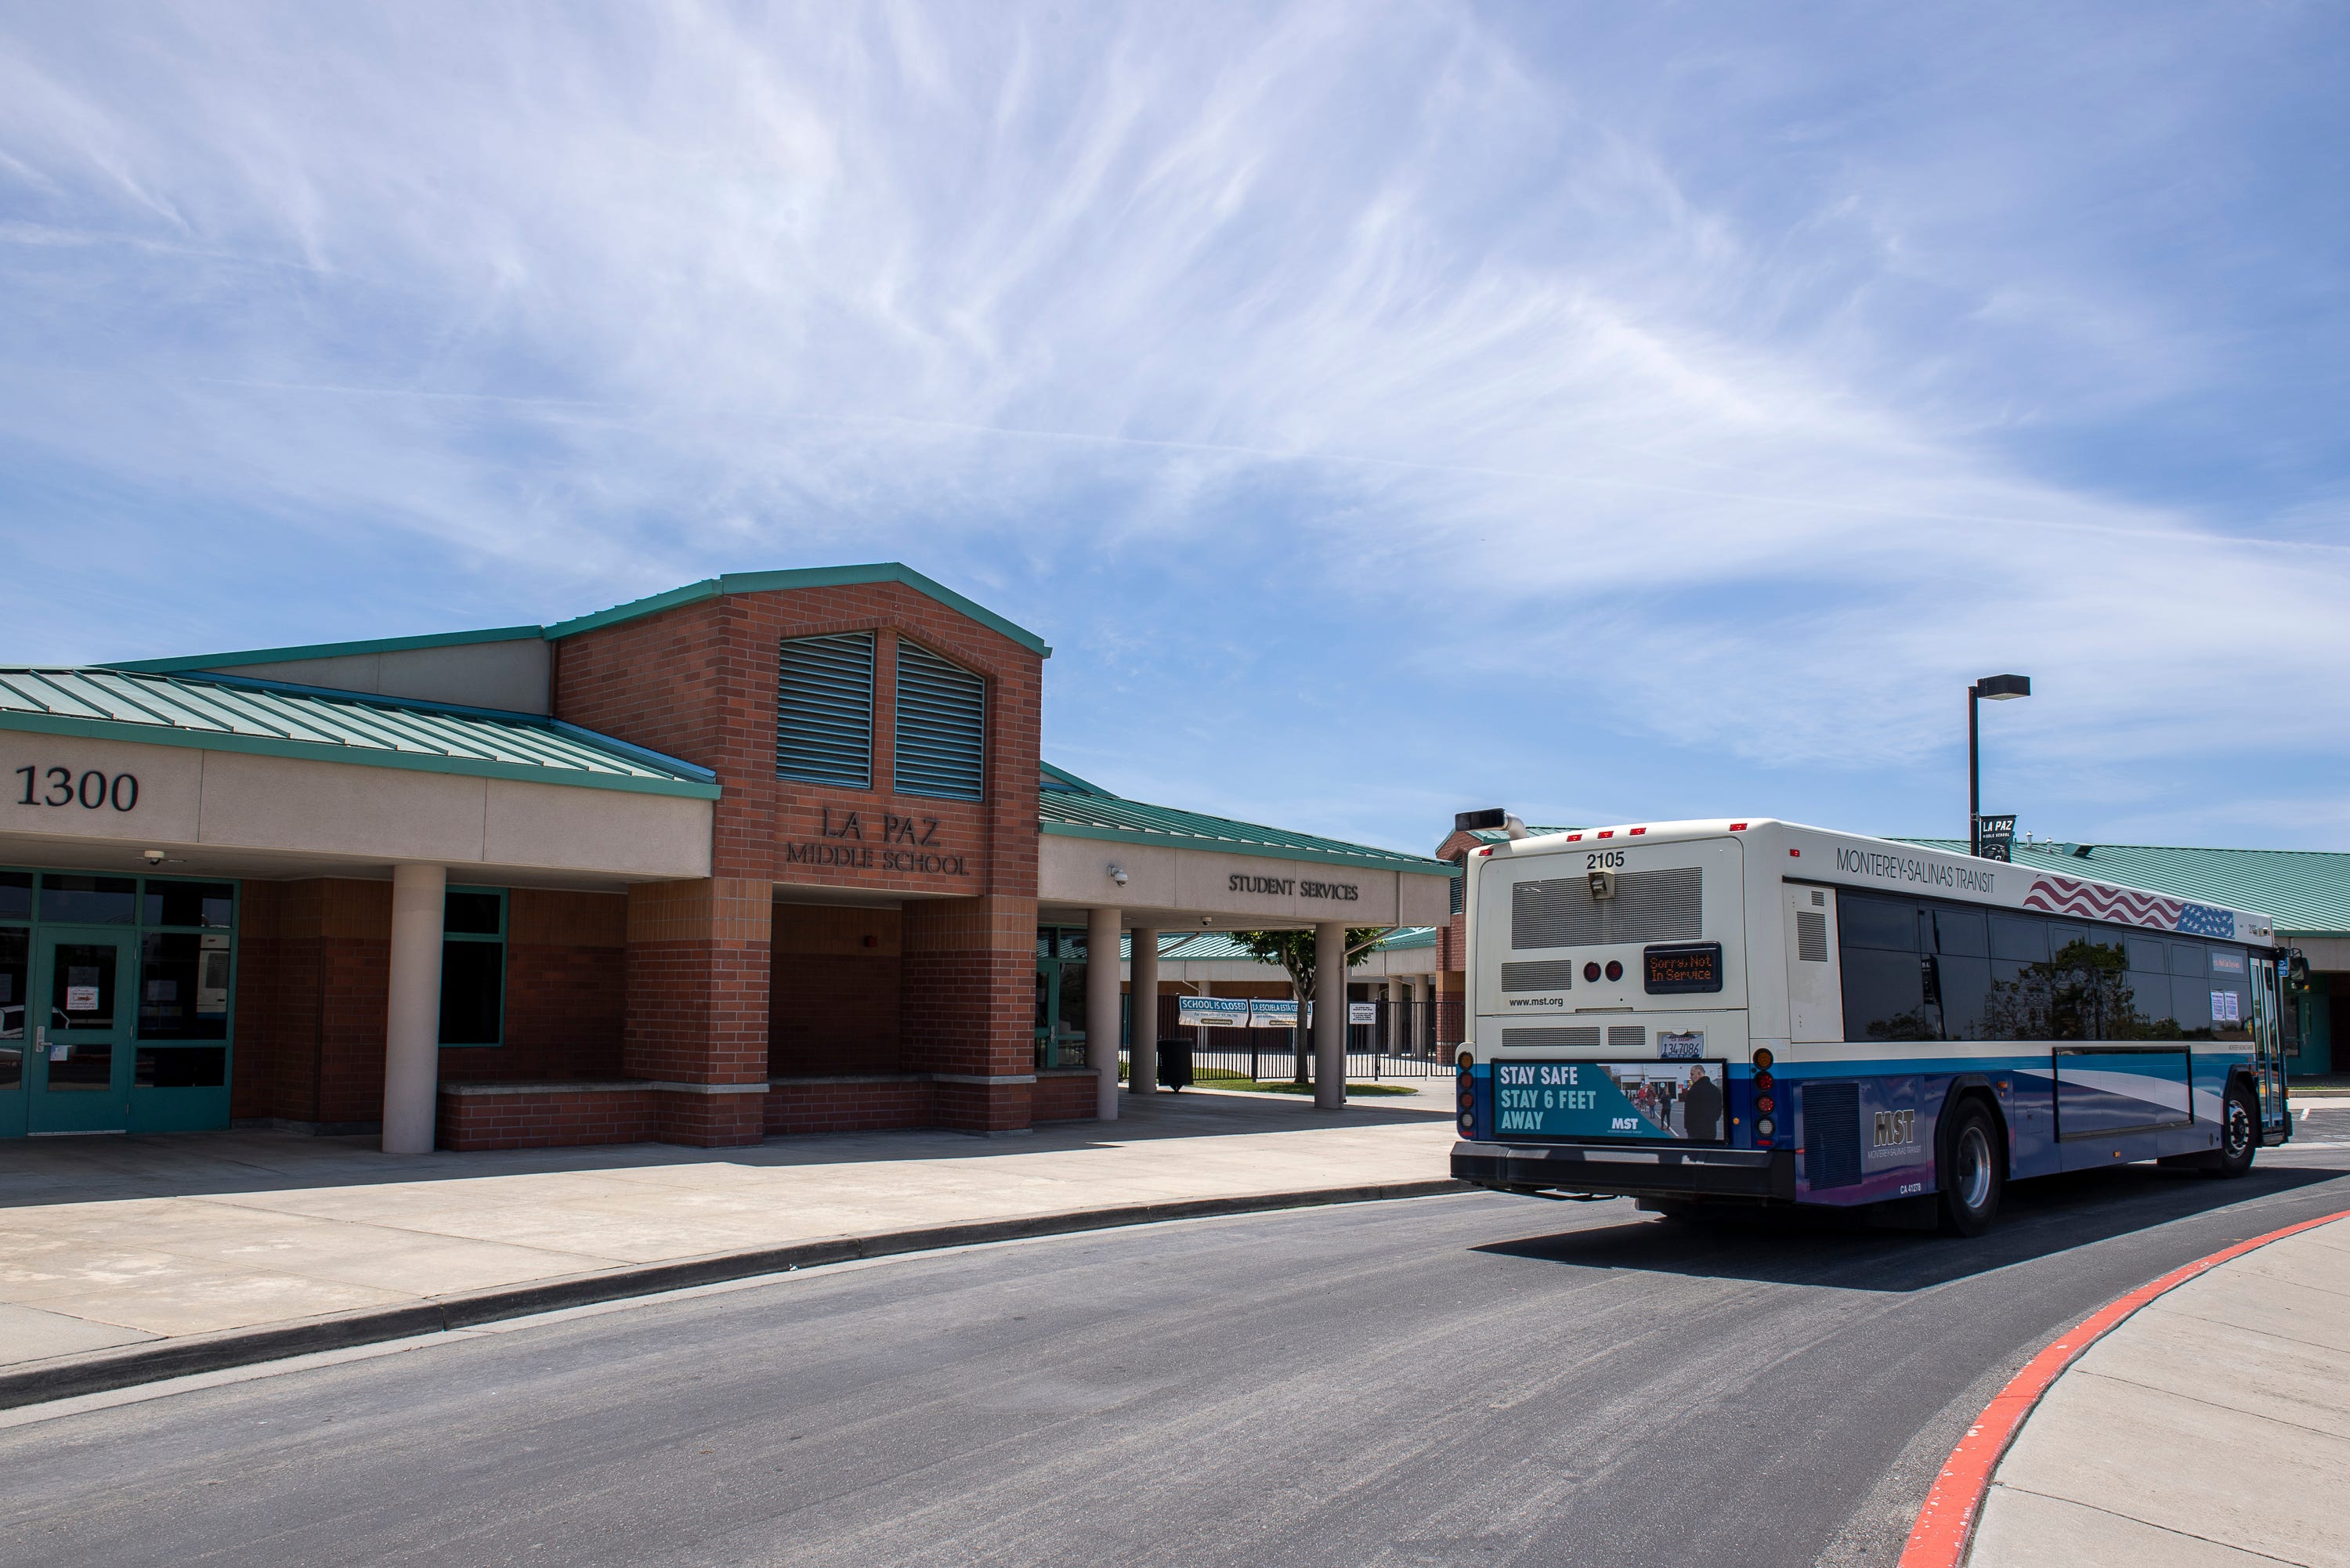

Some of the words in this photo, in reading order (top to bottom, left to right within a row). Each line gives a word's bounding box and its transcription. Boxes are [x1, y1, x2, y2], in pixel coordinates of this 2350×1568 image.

[16, 765, 139, 811] 1300
[823, 807, 863, 840] LA
[884, 813, 941, 847] PAZ
[1983, 821, 1993, 832] LA
[1995, 820, 2012, 831] PAZ
[786, 842, 873, 869] MIDDLE
[884, 851, 970, 876] SCHOOL
[1586, 851, 1625, 869] 2105
[1836, 847, 1953, 887] MONTEREY-SALINAS
[1955, 867, 1994, 893] TRANSIT
[1228, 875, 1295, 896] STUDENT
[1300, 881, 1358, 901] SERVICES
[1650, 957, 1688, 969] Sorry,
[1690, 955, 1712, 967] Not
[1652, 970, 1664, 981] In
[1666, 969, 1712, 981] Service
[1182, 999, 1213, 1010] SCHOOL
[1214, 1001, 1220, 1010] IS
[1221, 1002, 1246, 1010] CLOSED
[1509, 997, 1564, 1007] www.mst.org
[1663, 1042, 1700, 1054] 1347086
[1500, 1066, 1535, 1085] STAY
[1540, 1066, 1578, 1085] SAFE
[1501, 1089, 1538, 1108] STAY
[1544, 1089, 1554, 1108] 6
[1559, 1090, 1596, 1109] FEET
[1501, 1111, 1544, 1129] AWAY
[1611, 1118, 1638, 1129] MST
[1873, 1109, 1914, 1147] MST
[1900, 1185, 1907, 1194] CA
